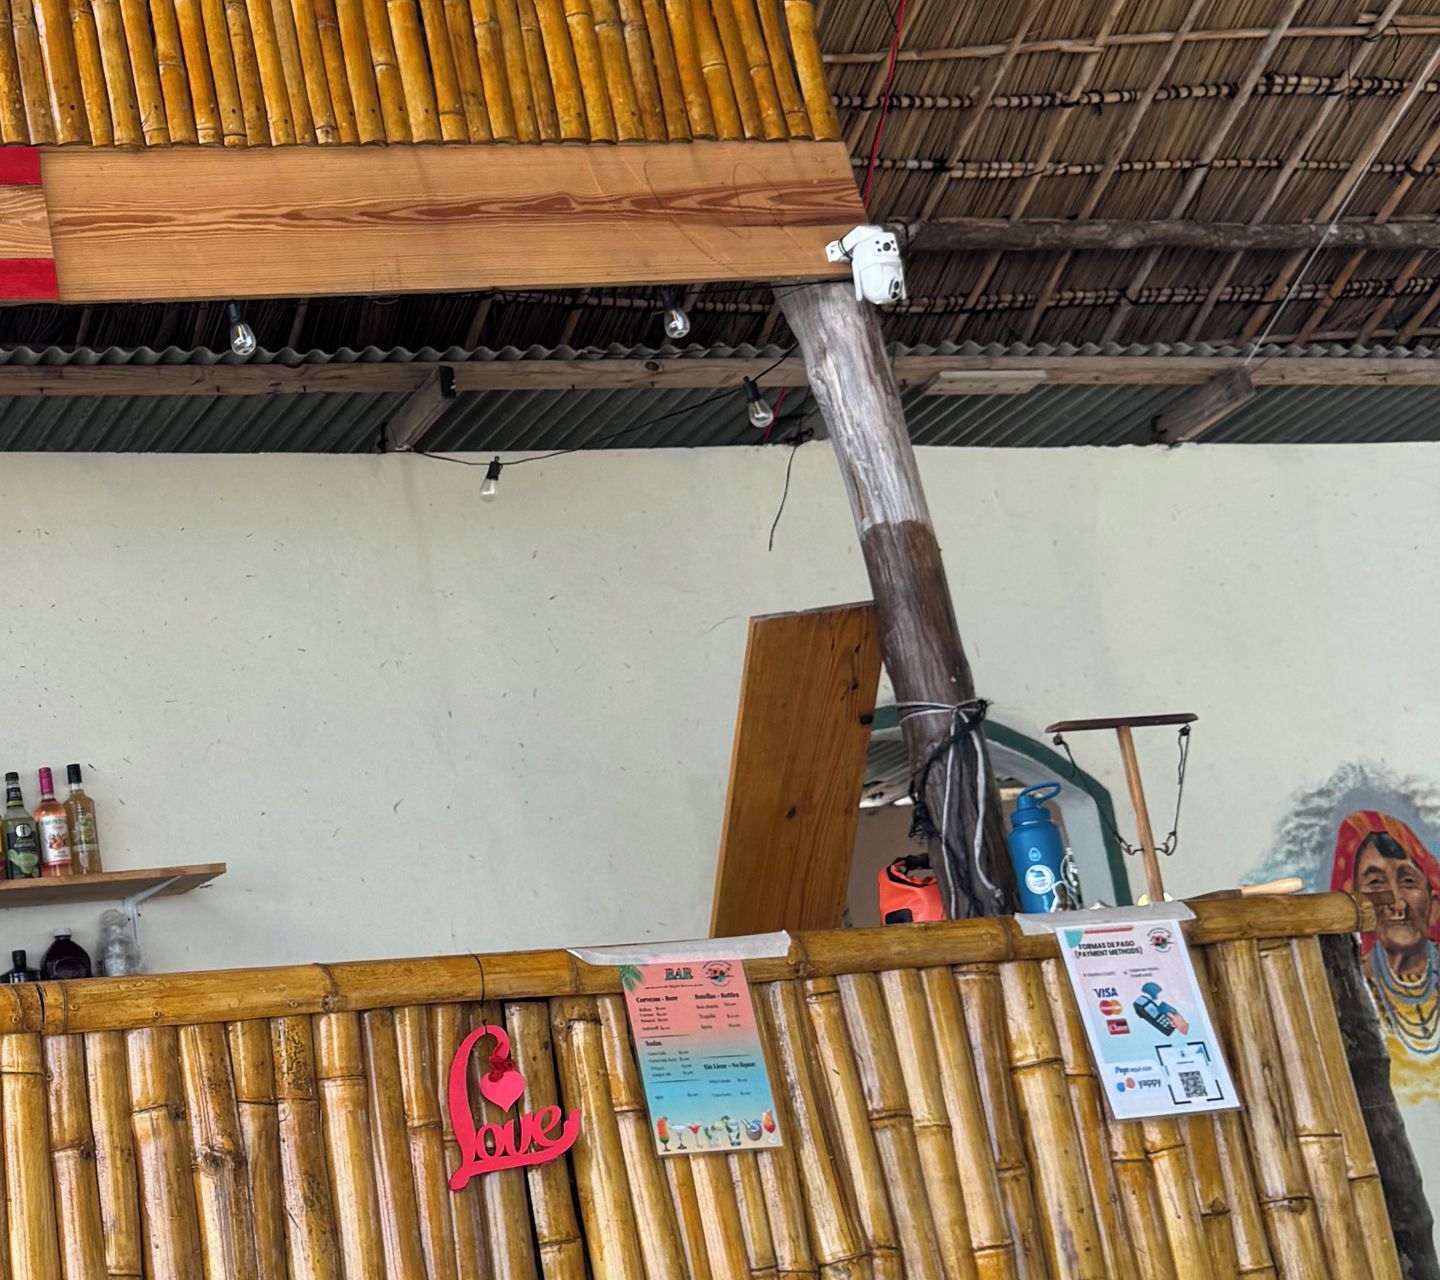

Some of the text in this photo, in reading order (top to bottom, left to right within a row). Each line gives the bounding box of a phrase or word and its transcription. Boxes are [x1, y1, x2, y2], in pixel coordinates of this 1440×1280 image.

[1078, 942, 1106, 950] FORMAS
[1115, 940, 1135, 948] PAGO
[1074, 946, 1143, 959] (PAYMENT METHODS)
[664, 967, 693, 981] BAR
[1093, 987, 1118, 998] VISA
[1137, 1078, 1161, 1089] yappy
[448, 1024, 582, 1191] Love
